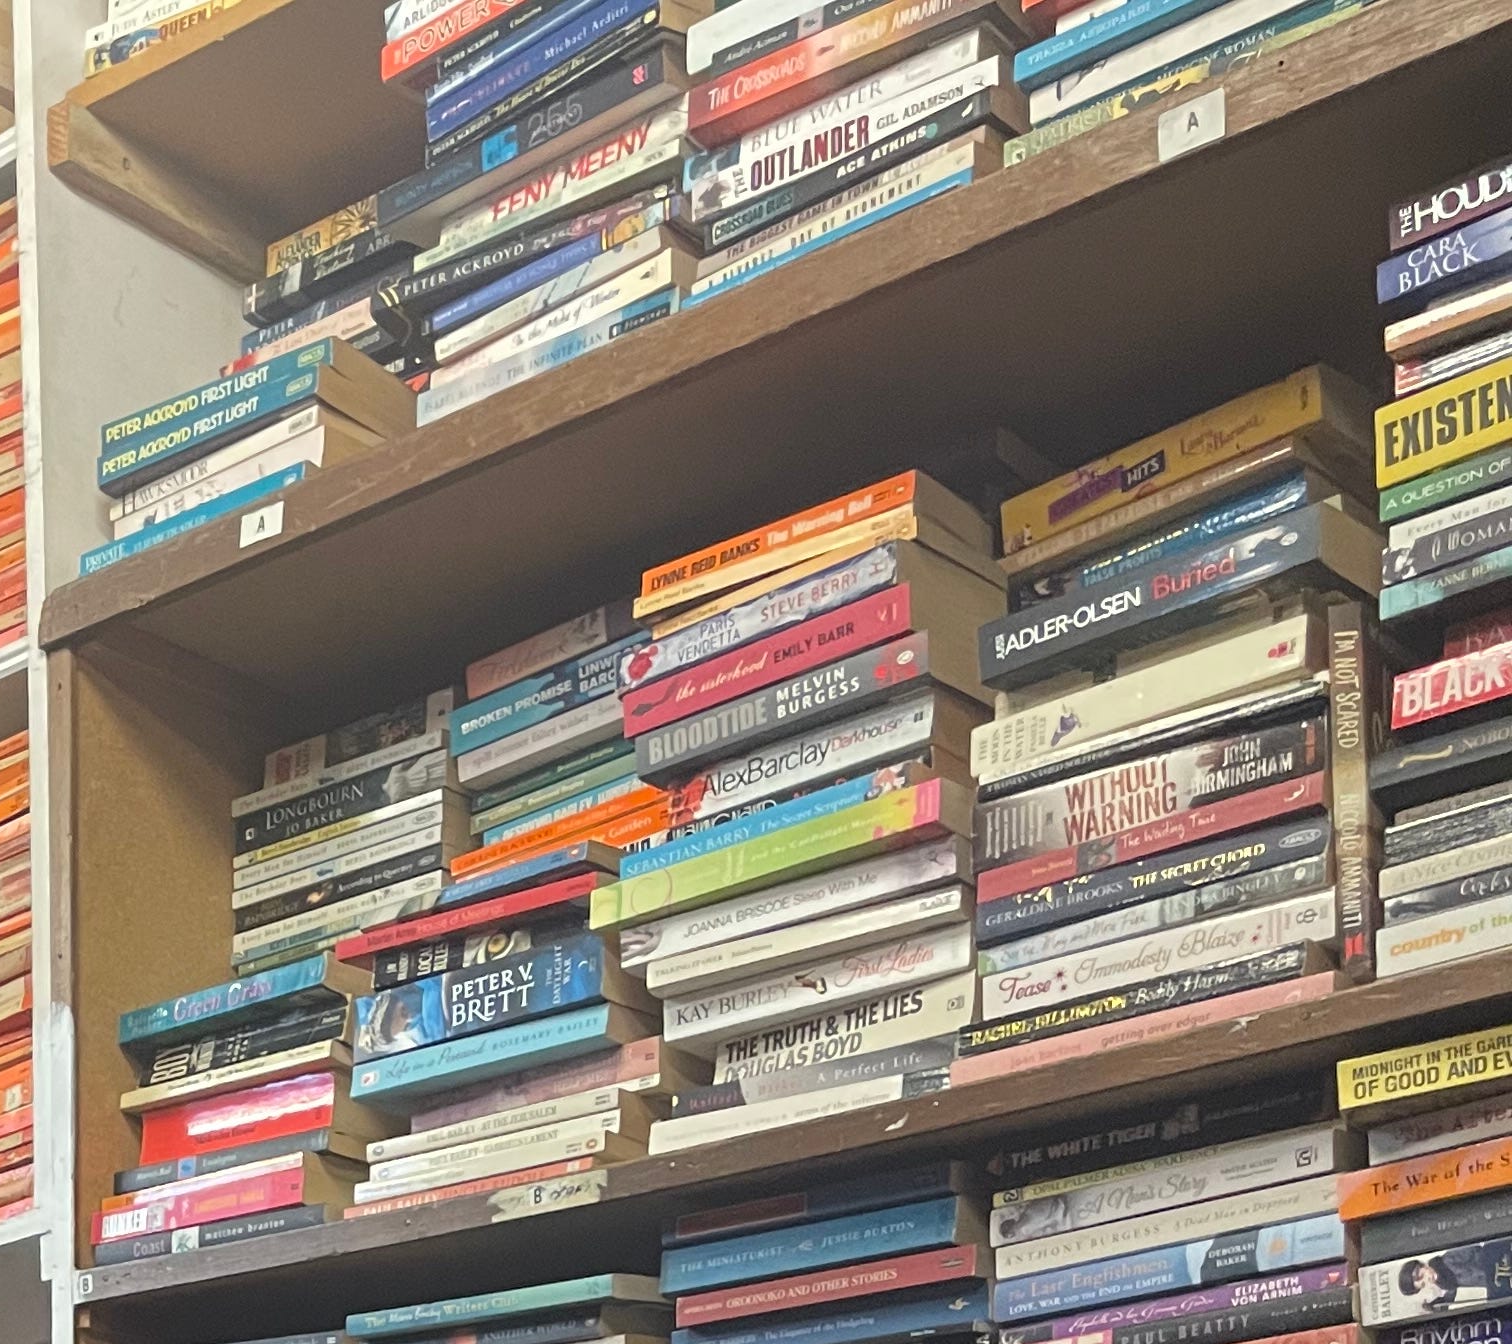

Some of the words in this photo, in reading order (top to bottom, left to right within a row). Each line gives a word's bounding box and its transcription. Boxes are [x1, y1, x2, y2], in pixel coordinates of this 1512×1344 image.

[902, 83, 964, 120] ADAMSON
[1187, 112, 1199, 131] A
[750, 115, 870, 191] OUTLANDER
[836, 157, 865, 178] ACE
[869, 127, 927, 162] ATKINS
[404, 272, 448, 297] PETER
[452, 242, 525, 287] ACKROYD
[1399, 247, 1481, 293] BLACK
[1408, 233, 1466, 268] CARA
[106, 421, 141, 443] PETER
[143, 397, 198, 432] ACKROYD
[200, 380, 231, 406] FIRST
[233, 366, 270, 394] LIGHT
[102, 453, 136, 475] PETER
[137, 428, 192, 462] ACKROYD
[193, 410, 224, 436] FIRST
[226, 398, 258, 424] LIGHT
[1385, 496, 1399, 510] A
[1401, 468, 1483, 506] QUESTION
[1488, 459, 1511, 482] OF
[256, 516, 266, 534] A
[761, 591, 808, 623] STEVE
[811, 570, 859, 603] BERRY
[1151, 554, 1237, 601] Buried
[773, 636, 815, 665] EMILY
[817, 622, 855, 647] BARR
[1004, 587, 1142, 654] ADLER-OLSEN
[460, 701, 512, 735] BROKEN
[514, 680, 573, 711] PROMISE
[776, 666, 846, 703] MELVIN
[776, 677, 861, 720] BURGESS
[649, 700, 768, 765] BLOODTIDE
[1221, 739, 1262, 766] JOHN
[265, 781, 364, 830] LONGBOURN
[1064, 755, 1169, 814] WITHOUT
[1063, 781, 1177, 846] WARNING
[452, 974, 503, 1002] PETER
[452, 983, 535, 1027] BRETT
[725, 1036, 758, 1064] THE
[761, 1013, 822, 1054] TRUTH
[841, 999, 880, 1030] THE
[883, 990, 923, 1020] LIES
[725, 1043, 809, 1085] DOUGLAS
[812, 1032, 863, 1063] BOYD
[1352, 1050, 1422, 1081] MIDNIGHT
[1425, 1048, 1441, 1063] IN
[1444, 1043, 1473, 1059] THE
[1353, 1080, 1381, 1100] OF
[1385, 1066, 1440, 1095] GOOD
[1446, 1058, 1489, 1083] AND
